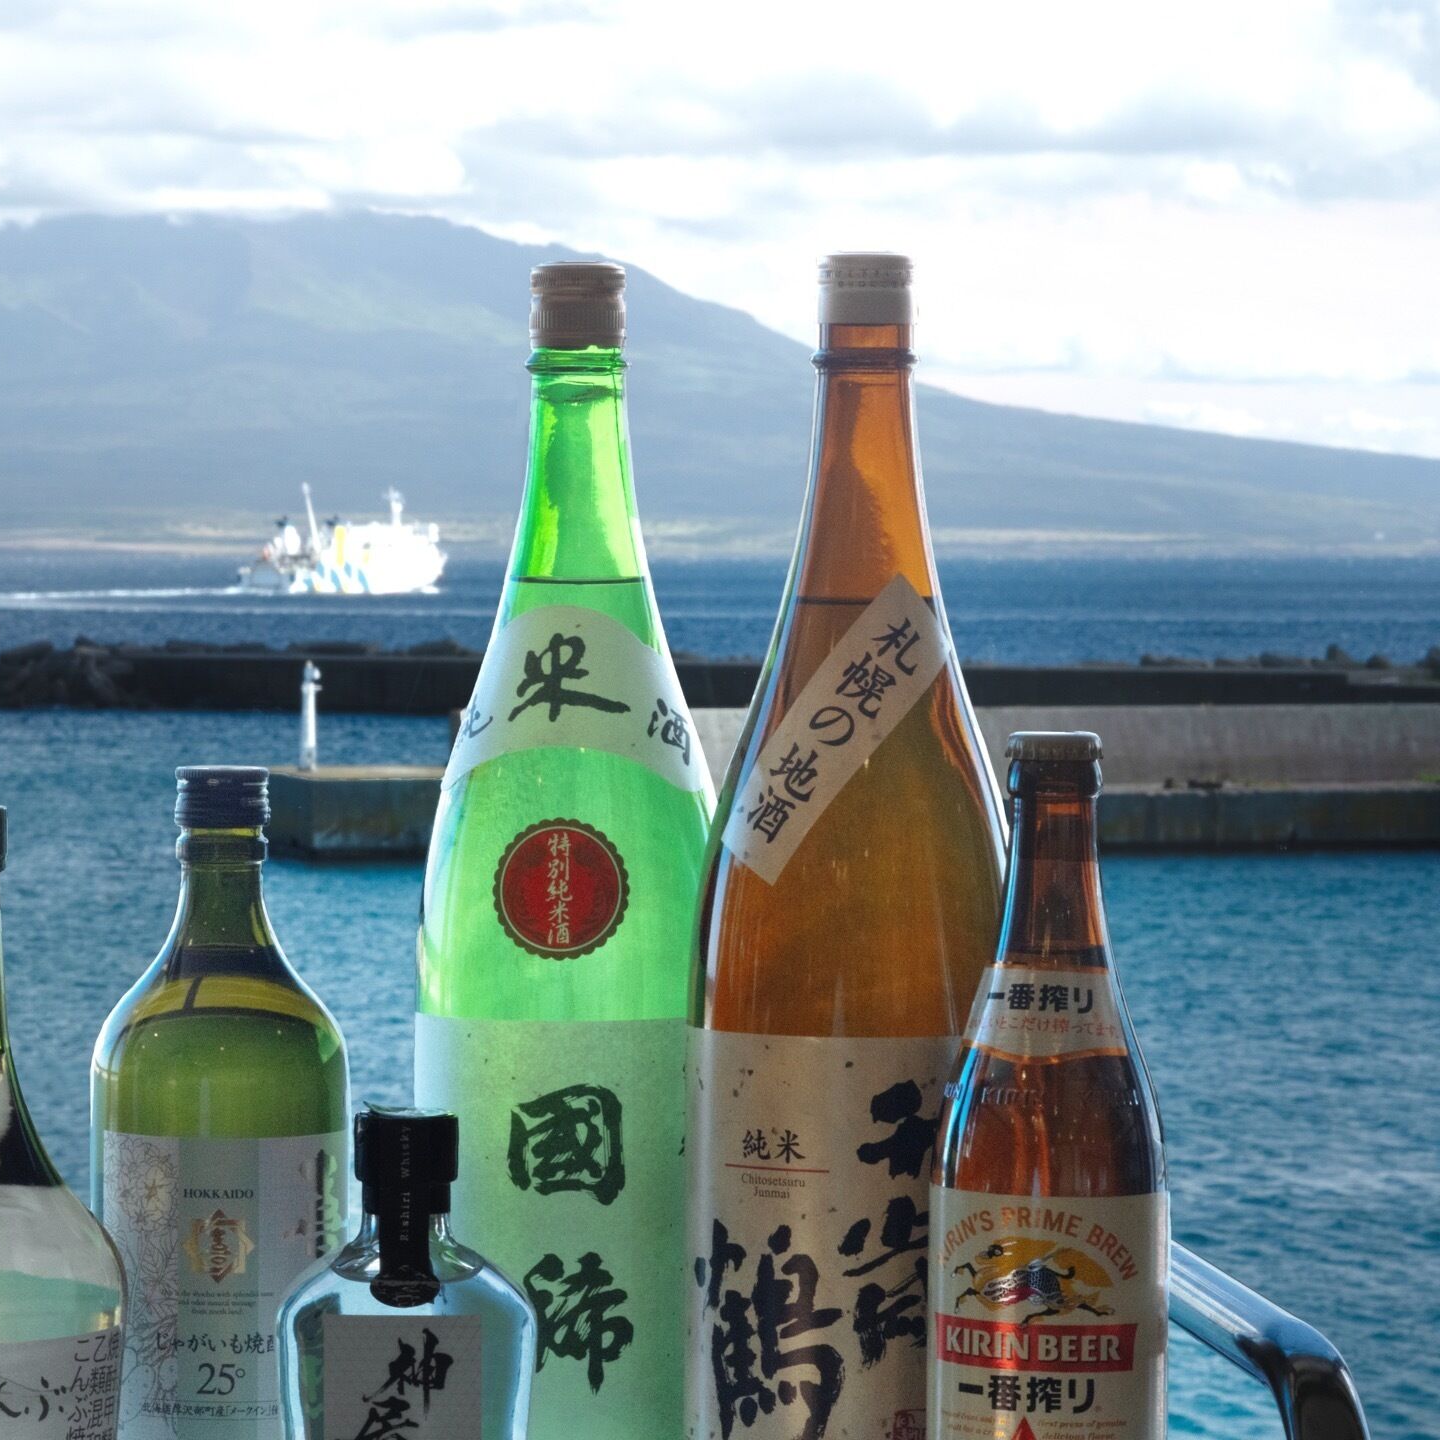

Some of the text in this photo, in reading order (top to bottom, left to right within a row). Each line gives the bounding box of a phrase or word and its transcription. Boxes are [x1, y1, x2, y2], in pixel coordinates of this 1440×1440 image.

[747, 618, 921, 844] 札幌の地酒
[546, 831, 573, 945] 特別純米酒
[987, 983, 1093, 1014] 一番搾り
[742, 1128, 806, 1164] 純米
[183, 1188, 255, 1200] HOKKAIDO
[741, 1173, 806, 1188] Chitosetsuru
[753, 1186, 791, 1200] Junmai
[937, 1206, 1139, 1281] KIRIN'S PRIME BREW
[946, 1325, 1121, 1362] KIRIN BEER
[87, 1335, 106, 1440] 乙類混
[958, 1375, 1095, 1413] 一番搾り
